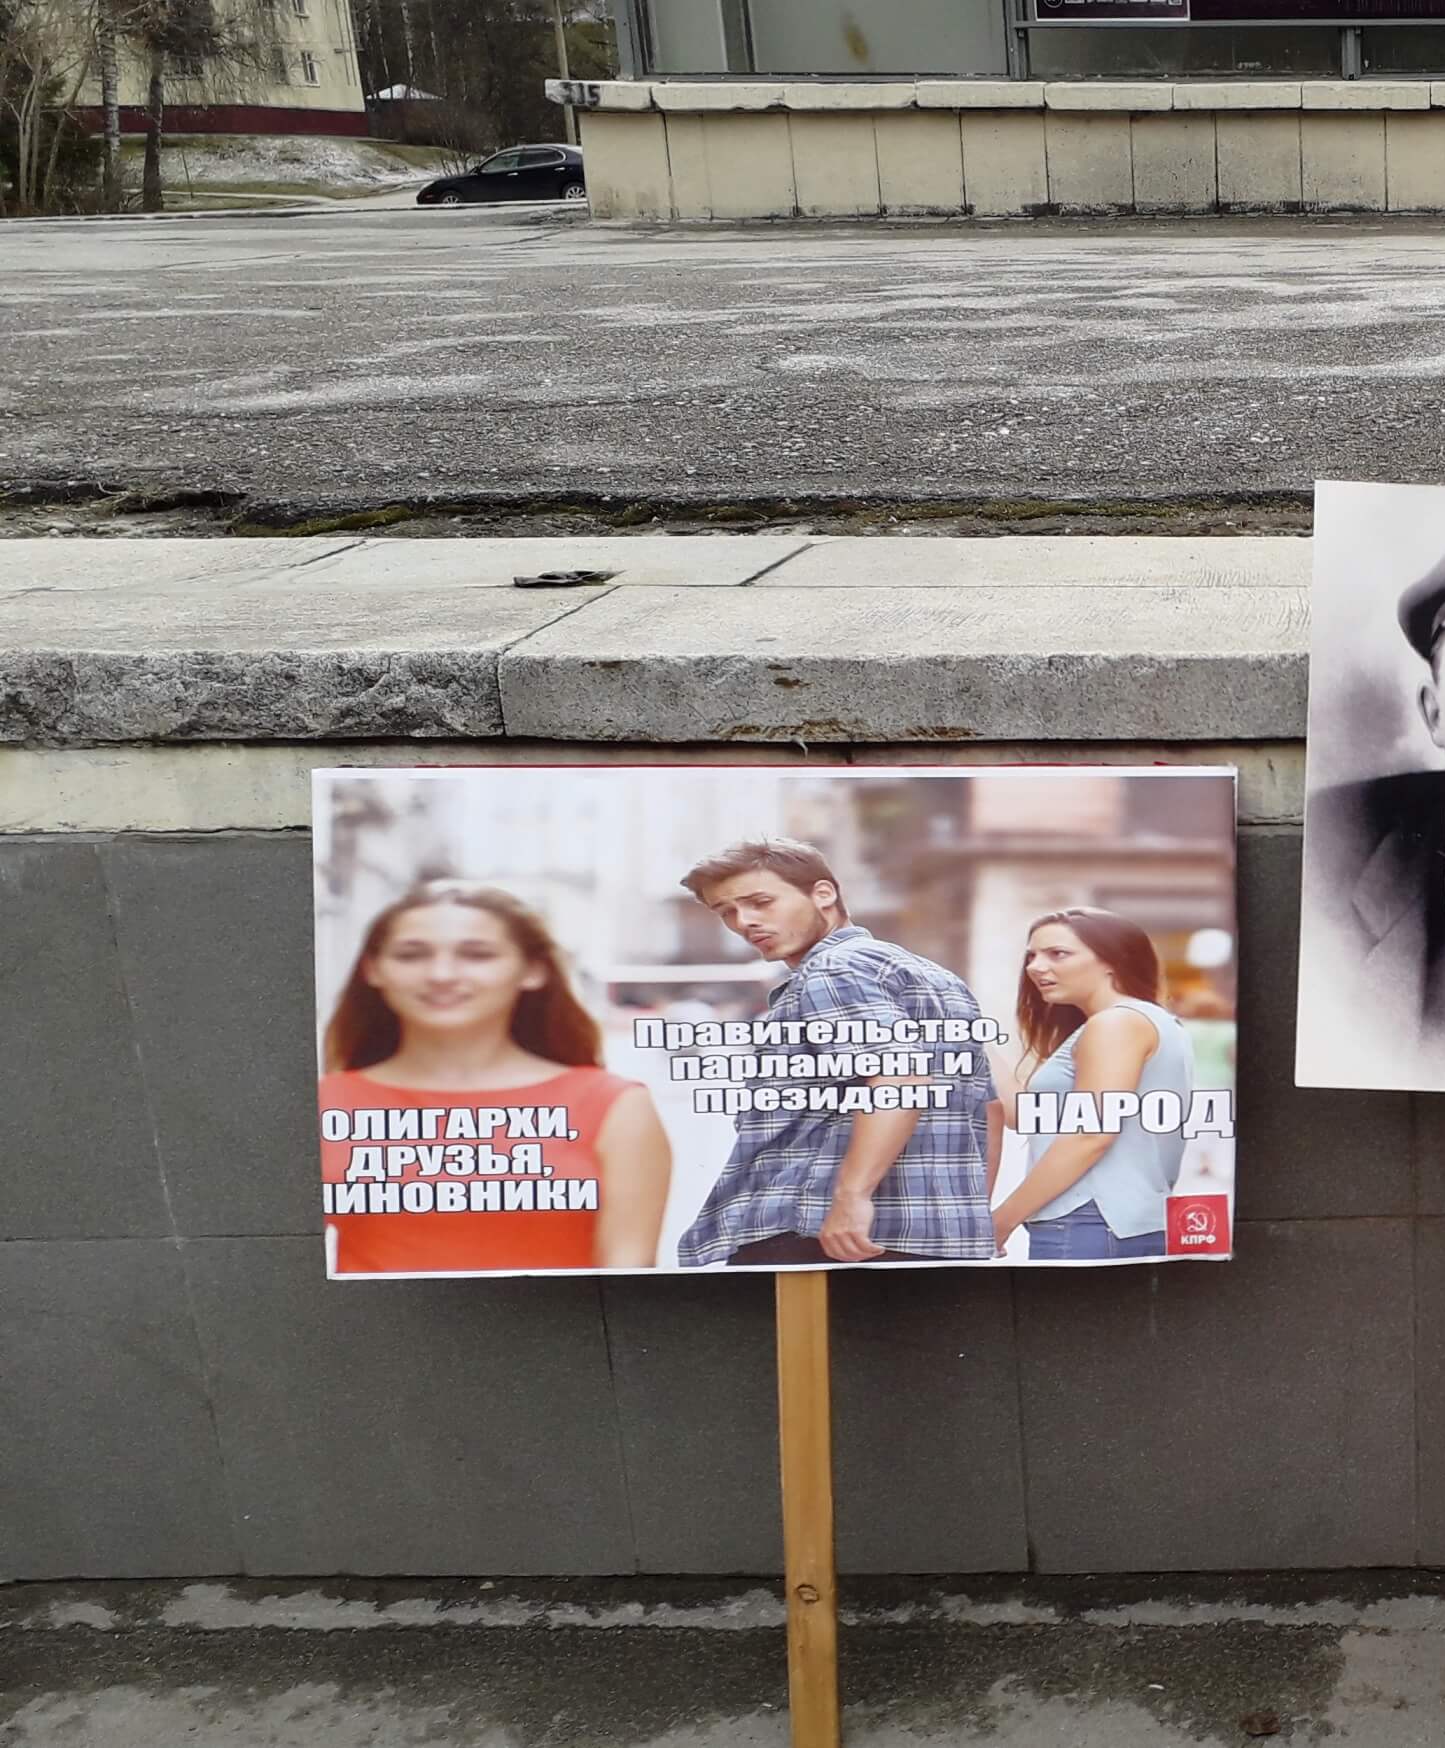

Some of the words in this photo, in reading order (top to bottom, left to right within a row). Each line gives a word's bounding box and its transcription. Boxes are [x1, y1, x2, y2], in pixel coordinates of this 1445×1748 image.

[634, 1018, 1009, 1050] Правительство,
[671, 1052, 933, 1081] парламент
[943, 1051, 973, 1076] и
[694, 1084, 953, 1114] президент
[1016, 1090, 1235, 1140] НАРОД
[321, 1106, 579, 1141] ОЛИГАРХИ,
[345, 1143, 553, 1182] ДРУЗЬЯ,
[1181, 1234, 1216, 1245] КПРФ
